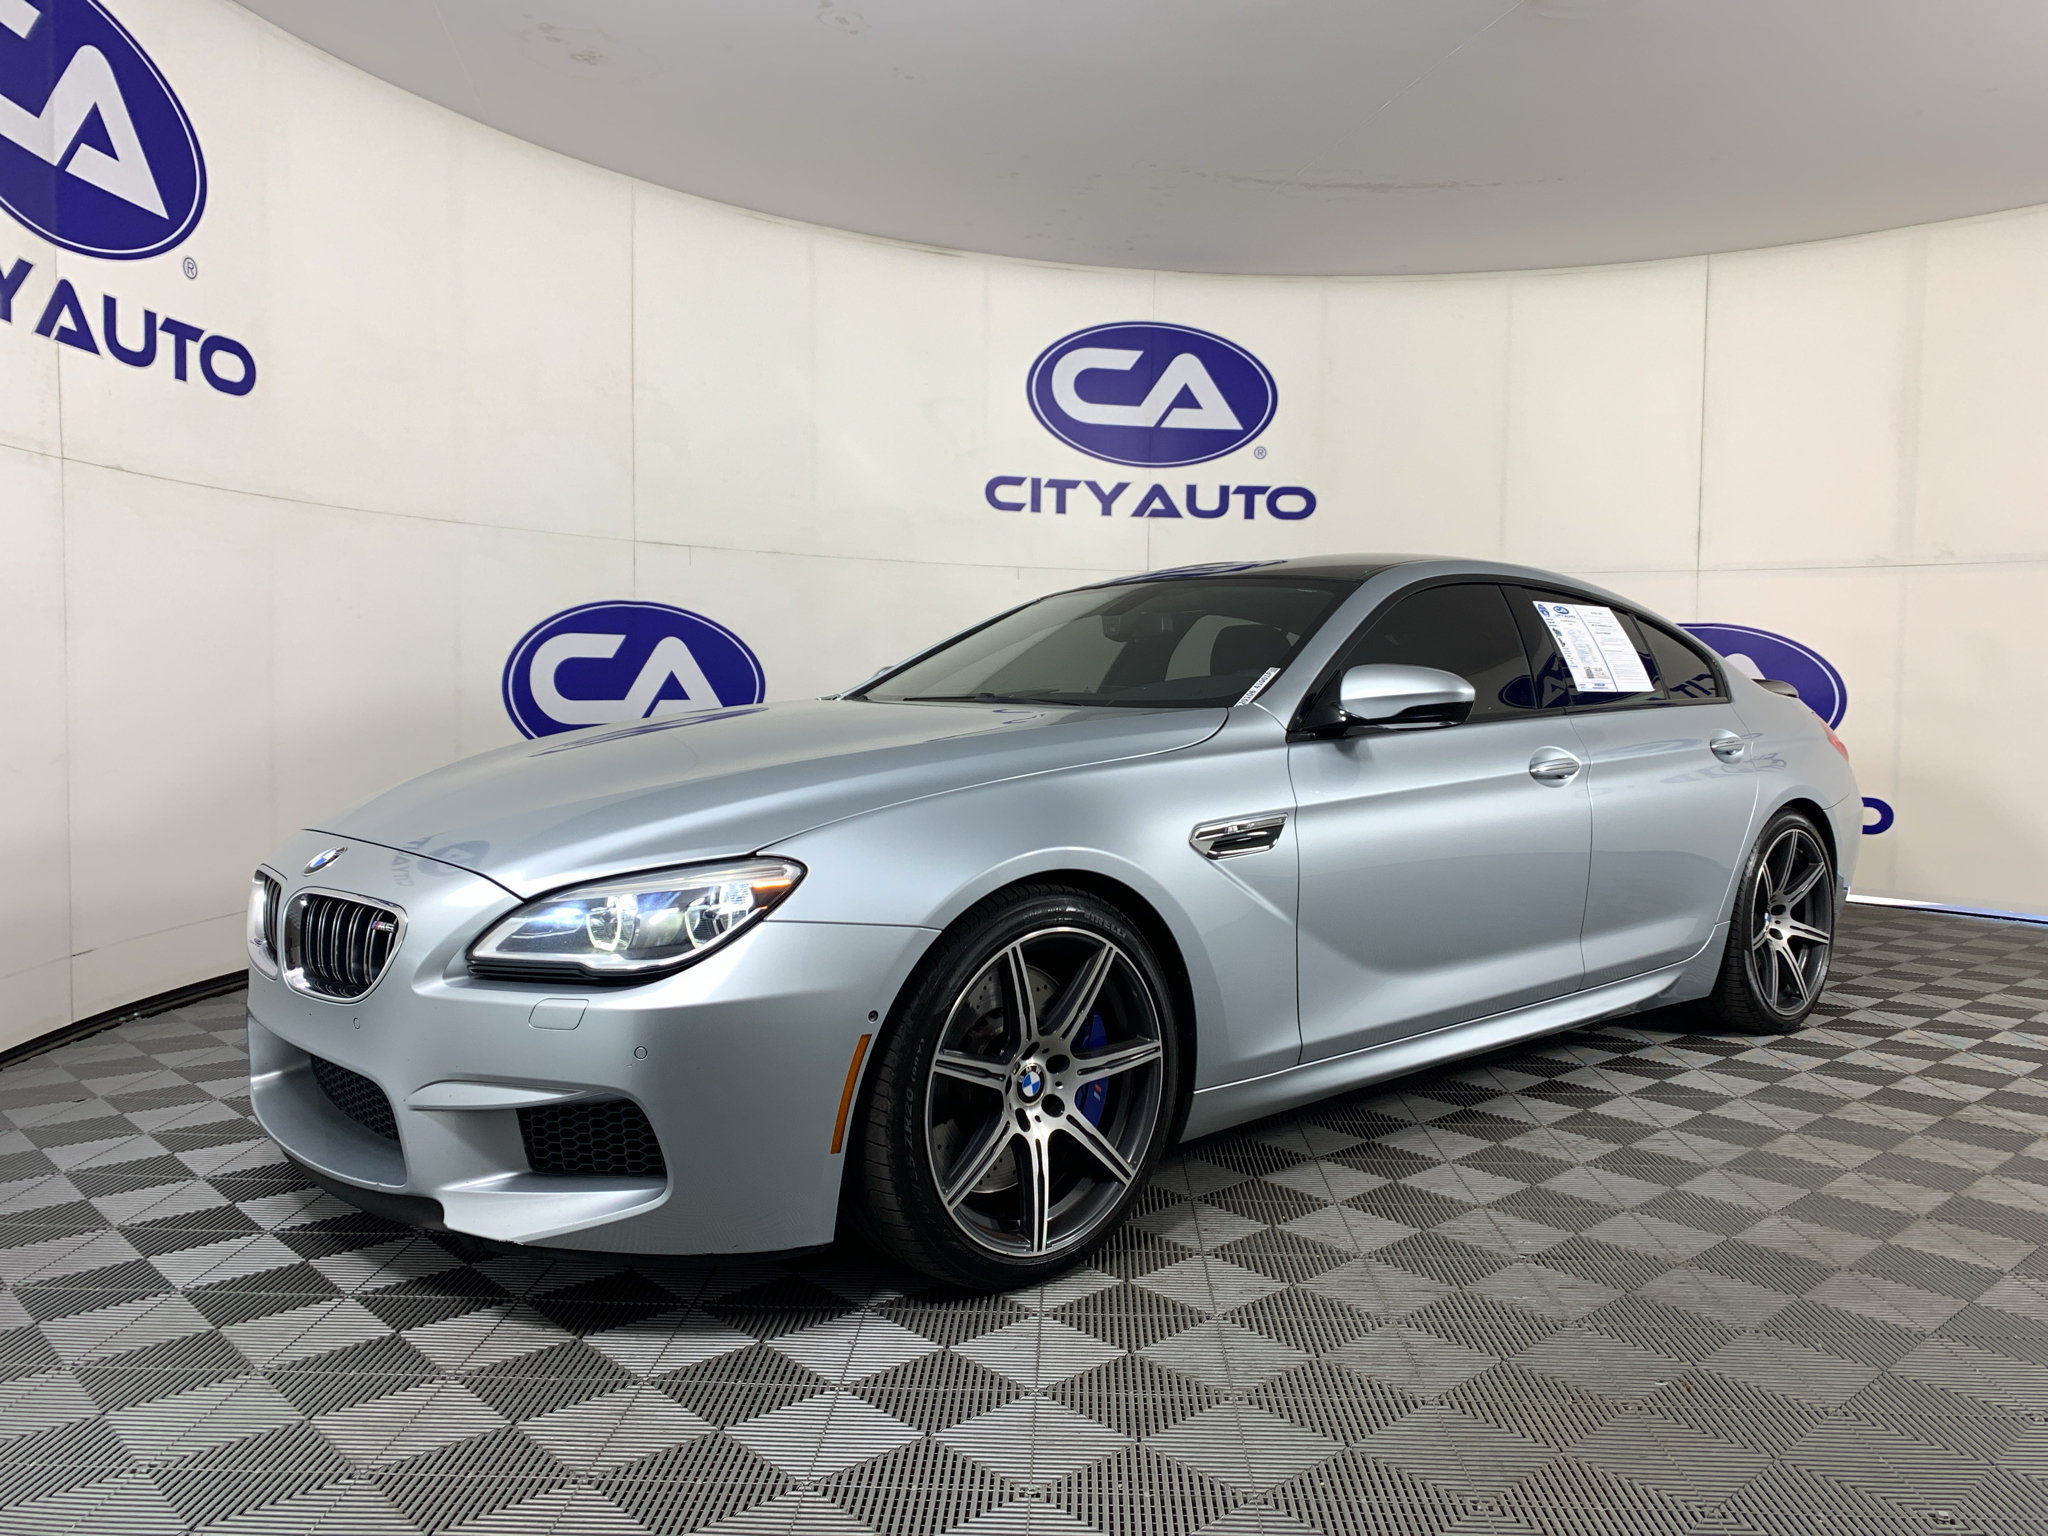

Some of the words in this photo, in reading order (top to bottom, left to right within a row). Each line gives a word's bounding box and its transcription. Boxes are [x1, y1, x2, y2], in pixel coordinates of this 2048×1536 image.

[34, 278, 256, 396] AUTO
[1051, 347, 1244, 430] CA
[985, 475, 1130, 517] CITY
[1130, 483, 1317, 520] AUTO
[529, 632, 724, 725] CA
